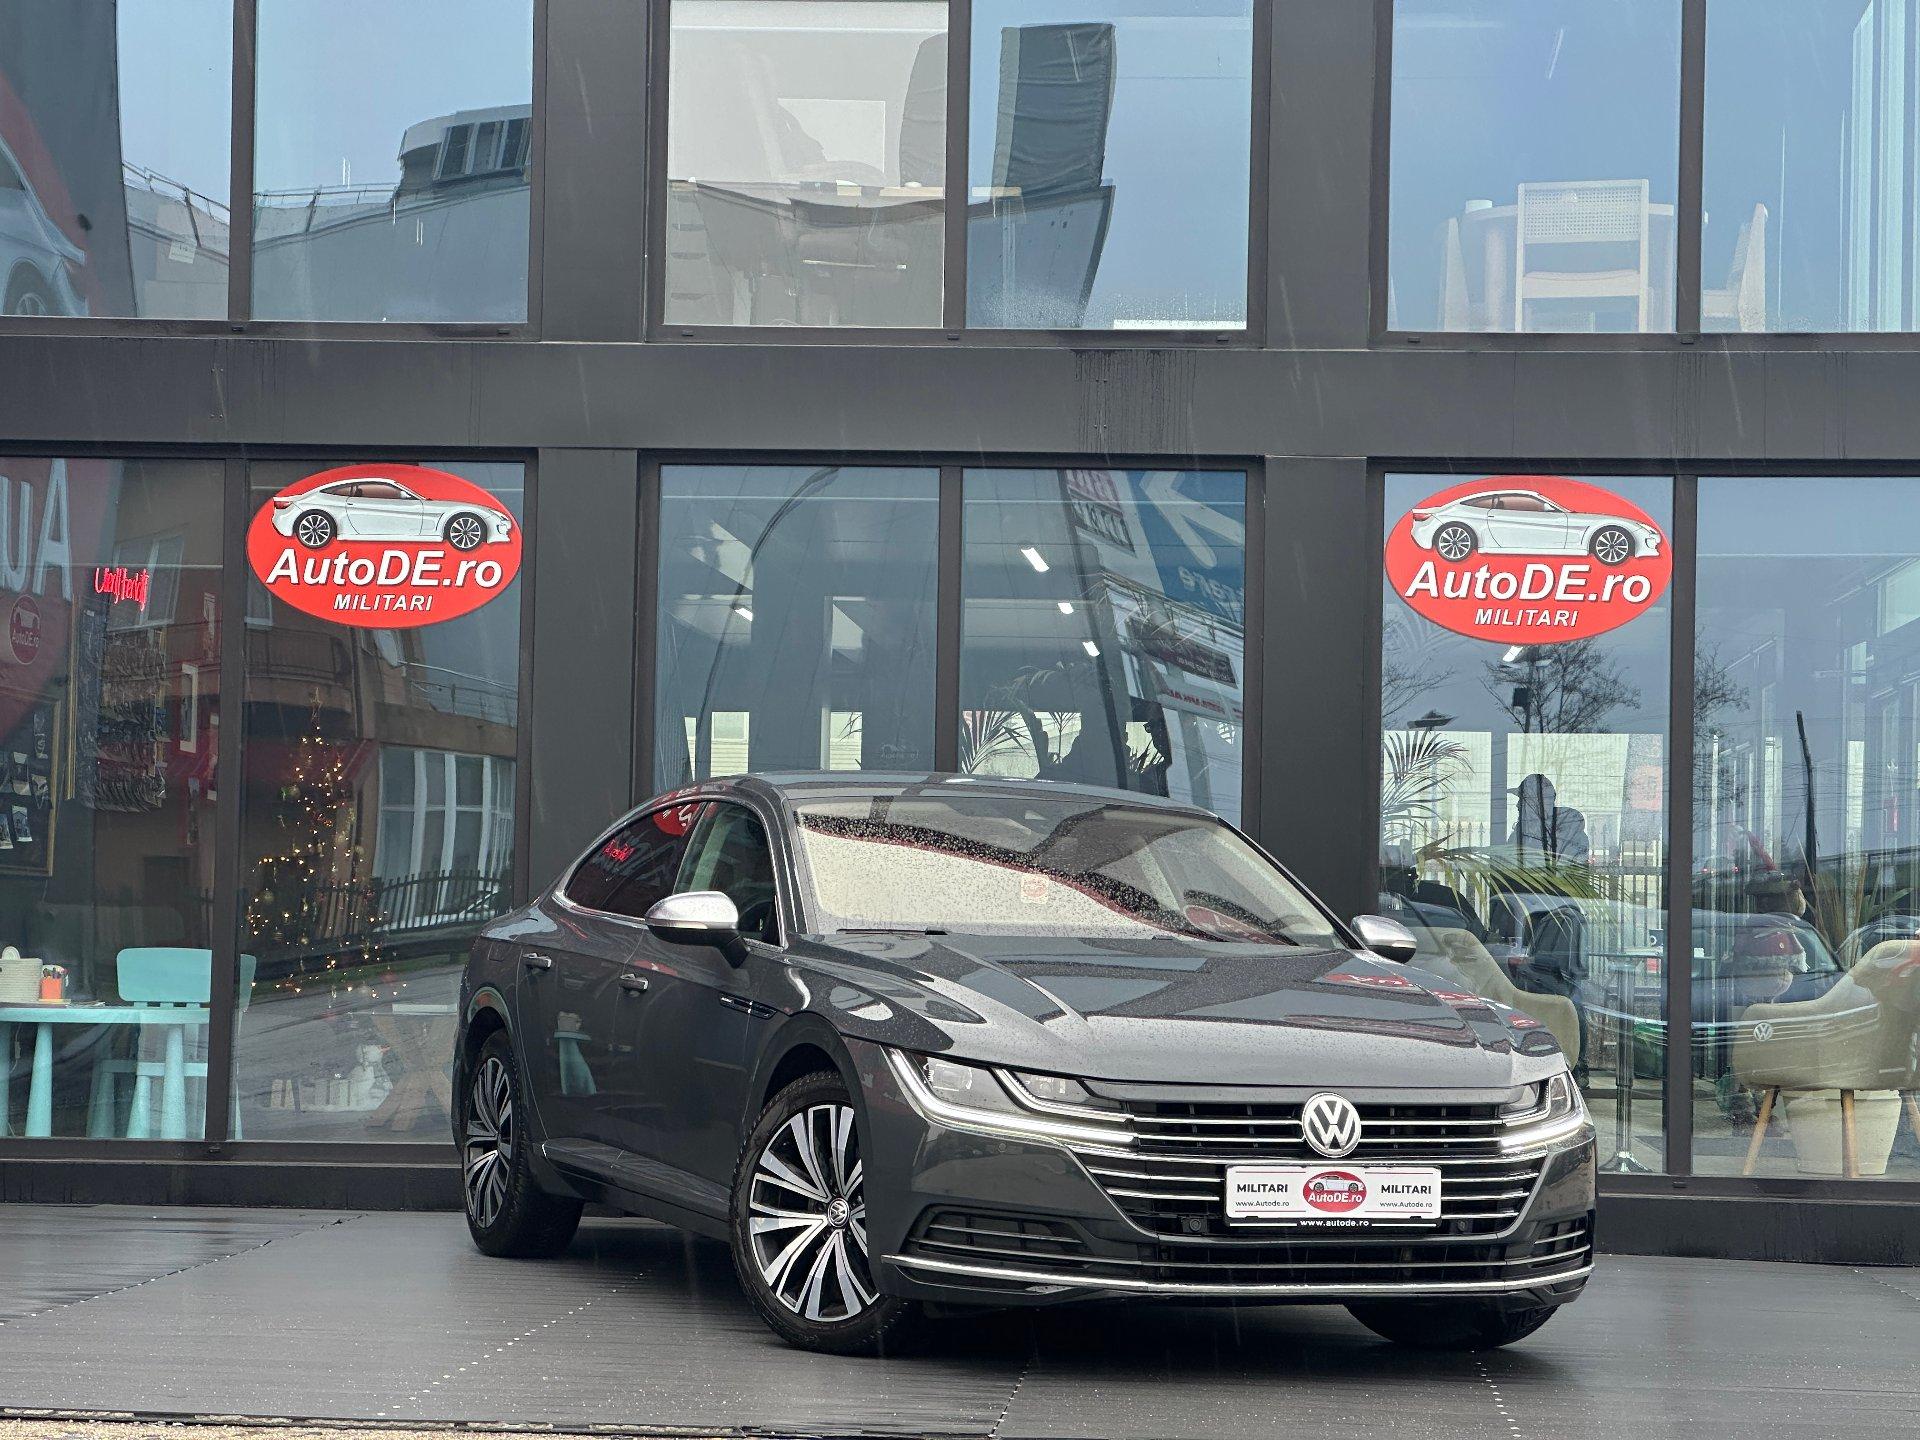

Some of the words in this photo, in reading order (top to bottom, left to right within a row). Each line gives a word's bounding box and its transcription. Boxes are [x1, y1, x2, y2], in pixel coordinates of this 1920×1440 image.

[266, 549, 503, 588] AutoDE.ro
[1404, 562, 1653, 604] AutoDE.ro
[333, 593, 434, 611] MILITARI
[1474, 608, 1579, 628] MILITARI
[1302, 1092, 1361, 1158] VW
[1236, 1183, 1289, 1194] MILITARI
[1380, 1184, 1432, 1195] MILITARI
[1235, 1199, 1290, 1208] www.Autode.ro
[1307, 1191, 1363, 1205] AutoDE.ro
[1379, 1200, 1433, 1209] www.Autode.ro
[1299, 1219, 1370, 1228] www.autode.ro
